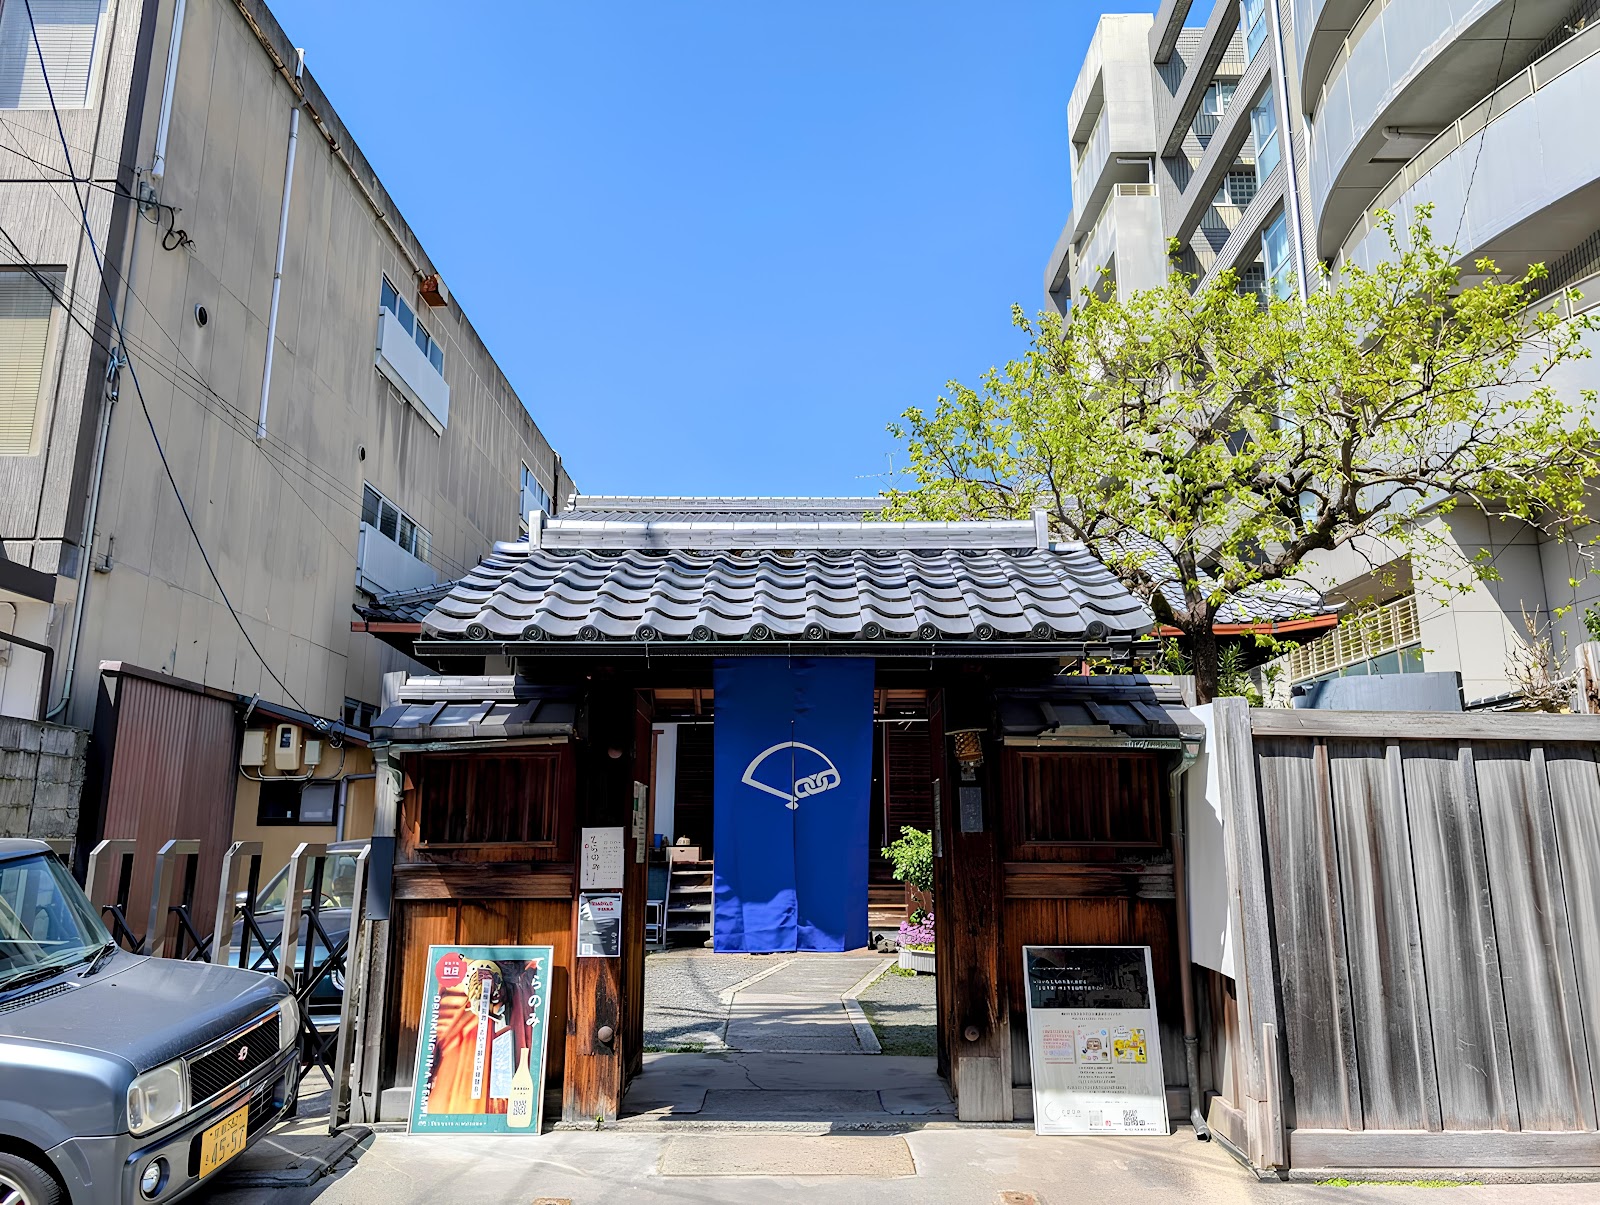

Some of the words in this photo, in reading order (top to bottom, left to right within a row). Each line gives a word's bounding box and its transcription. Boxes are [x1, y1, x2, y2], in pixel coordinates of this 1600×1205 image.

[525, 957, 545, 1028] てらのみ
[427, 995, 442, 1051] DRINKING
[211, 1124, 246, 1166] 45-57
